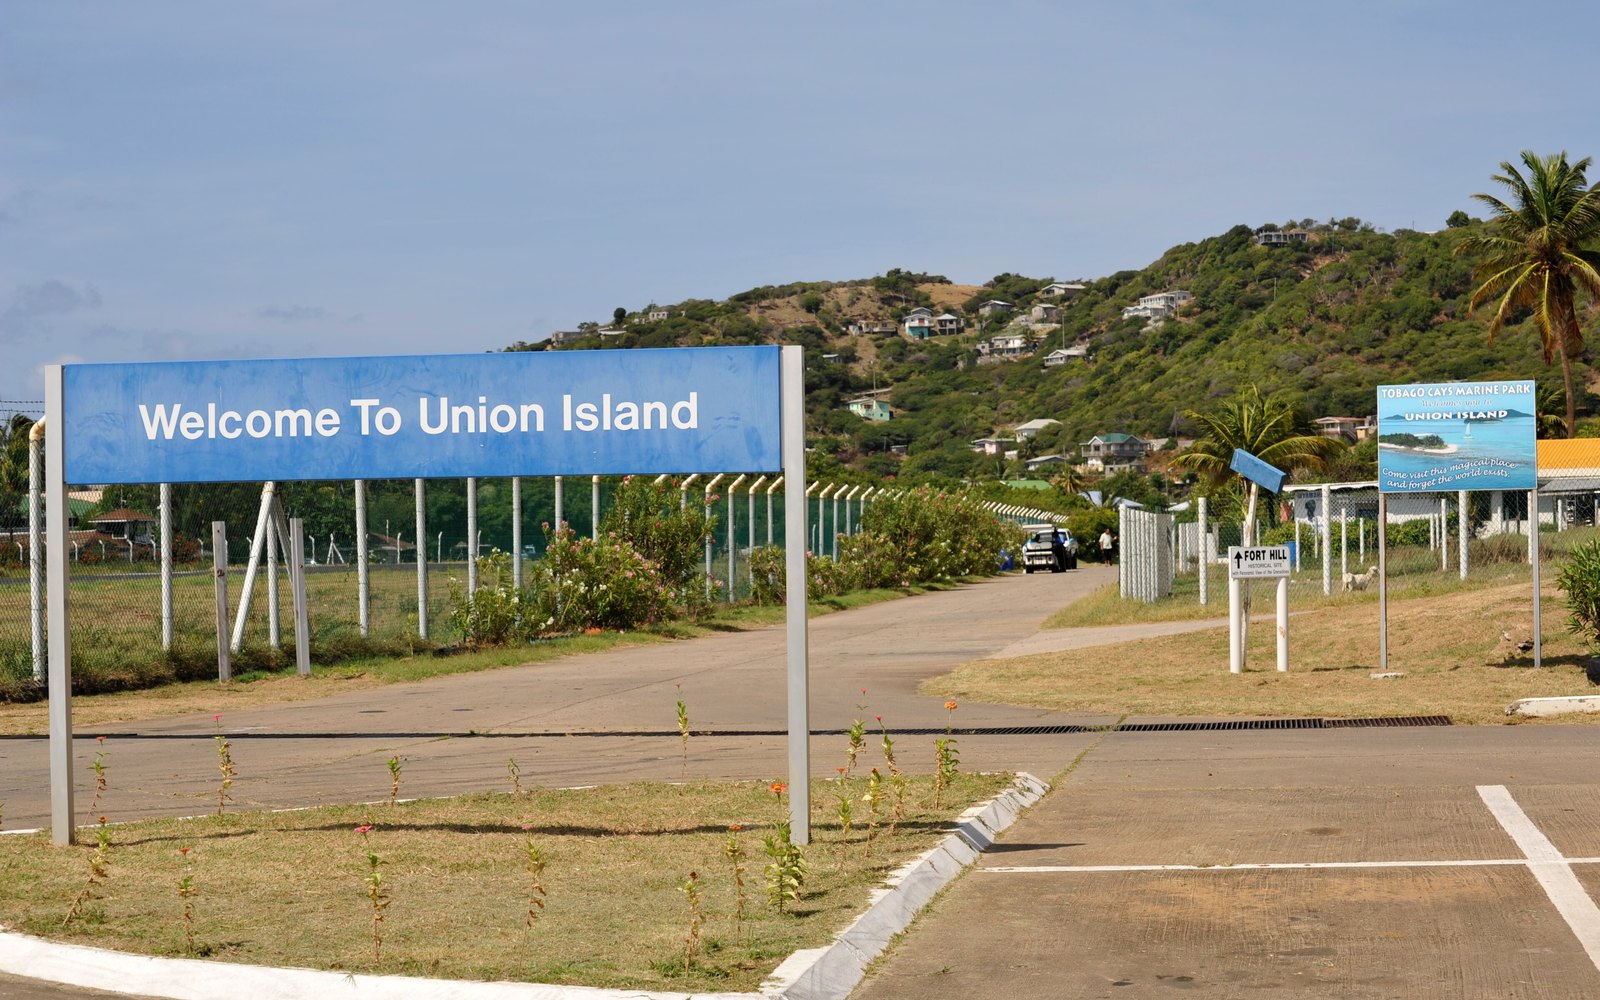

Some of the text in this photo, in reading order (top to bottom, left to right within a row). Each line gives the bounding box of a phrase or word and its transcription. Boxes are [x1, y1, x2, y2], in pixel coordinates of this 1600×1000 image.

[1381, 384, 1531, 399] TOBAGO CAYS MARINE PARK
[138, 391, 698, 440] Welcome To Union Island
[1404, 409, 1508, 421] UNION ISLAND
[1382, 458, 1518, 479] Come visit this magical place
[1387, 479, 1408, 489] and
[1408, 478, 1437, 490] forget
[1438, 474, 1454, 485] the
[1454, 468, 1482, 481] world
[1244, 549, 1287, 561] FORT HILL
